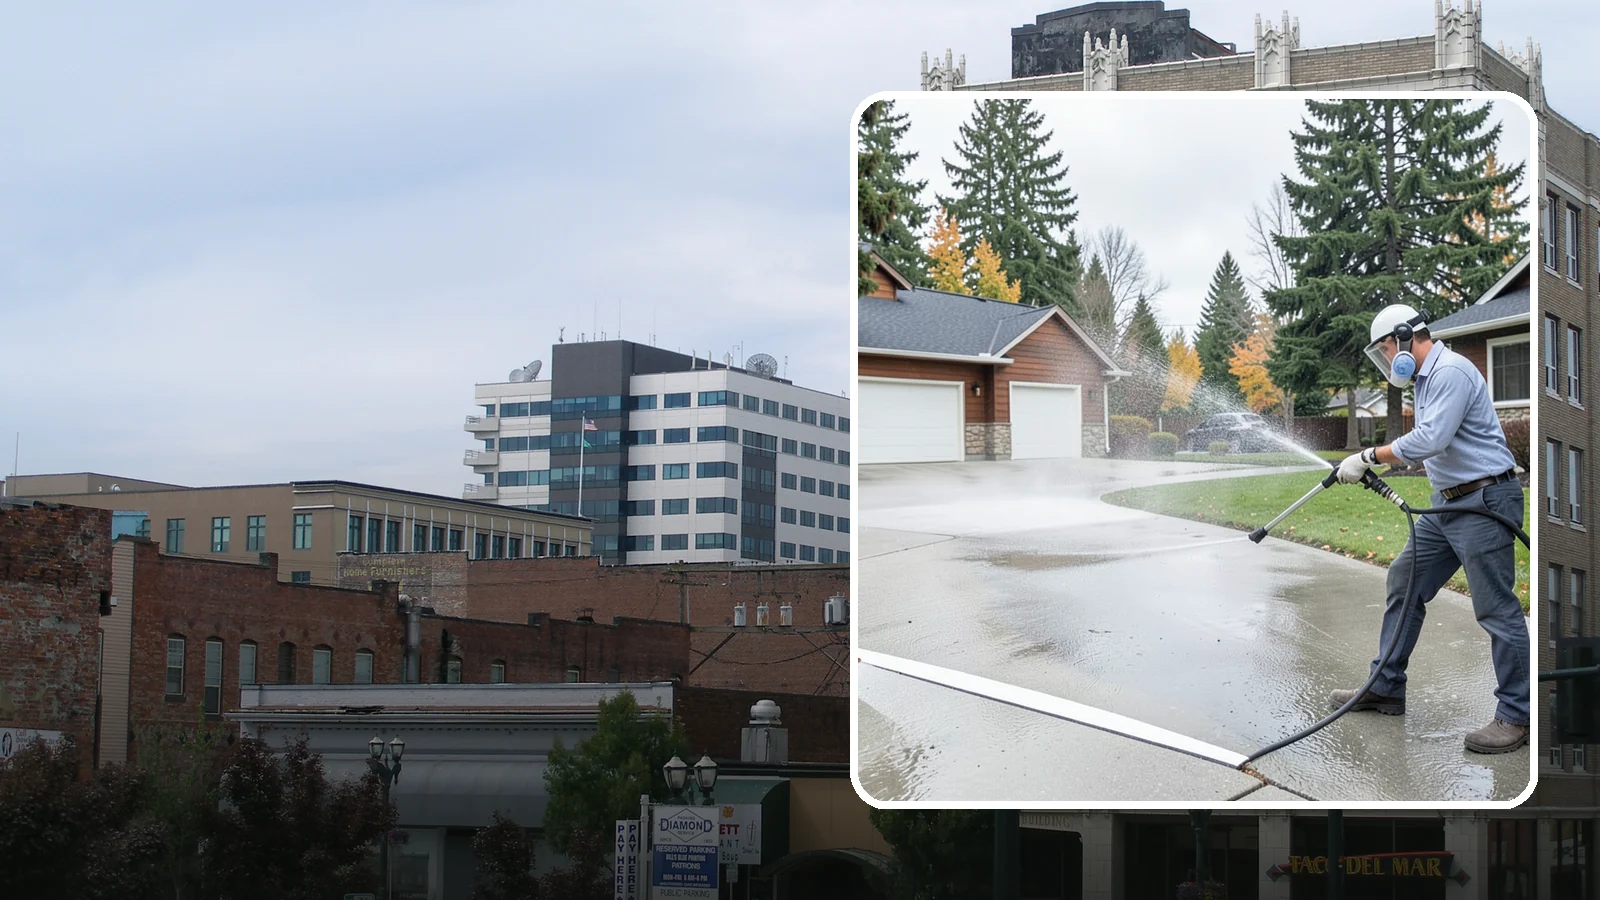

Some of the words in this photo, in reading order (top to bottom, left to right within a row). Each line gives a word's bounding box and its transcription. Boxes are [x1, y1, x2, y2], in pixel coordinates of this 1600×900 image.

[343, 567, 368, 577] Home
[370, 566, 426, 576] Furnishers
[660, 818, 713, 833] DIAMOND
[1022, 815, 1070, 828] BUILDING
[617, 825, 625, 853] PAY
[628, 824, 637, 853] PAY
[689, 846, 716, 854] PARKING
[721, 851, 739, 862] Soup
[627, 855, 637, 893] HERE
[1346, 856, 1385, 876] DEL
[1391, 857, 1442, 877] MAR
[616, 856, 625, 893] HERE
[661, 889, 682, 897] PUBLIC
[683, 889, 710, 898] PARKING
